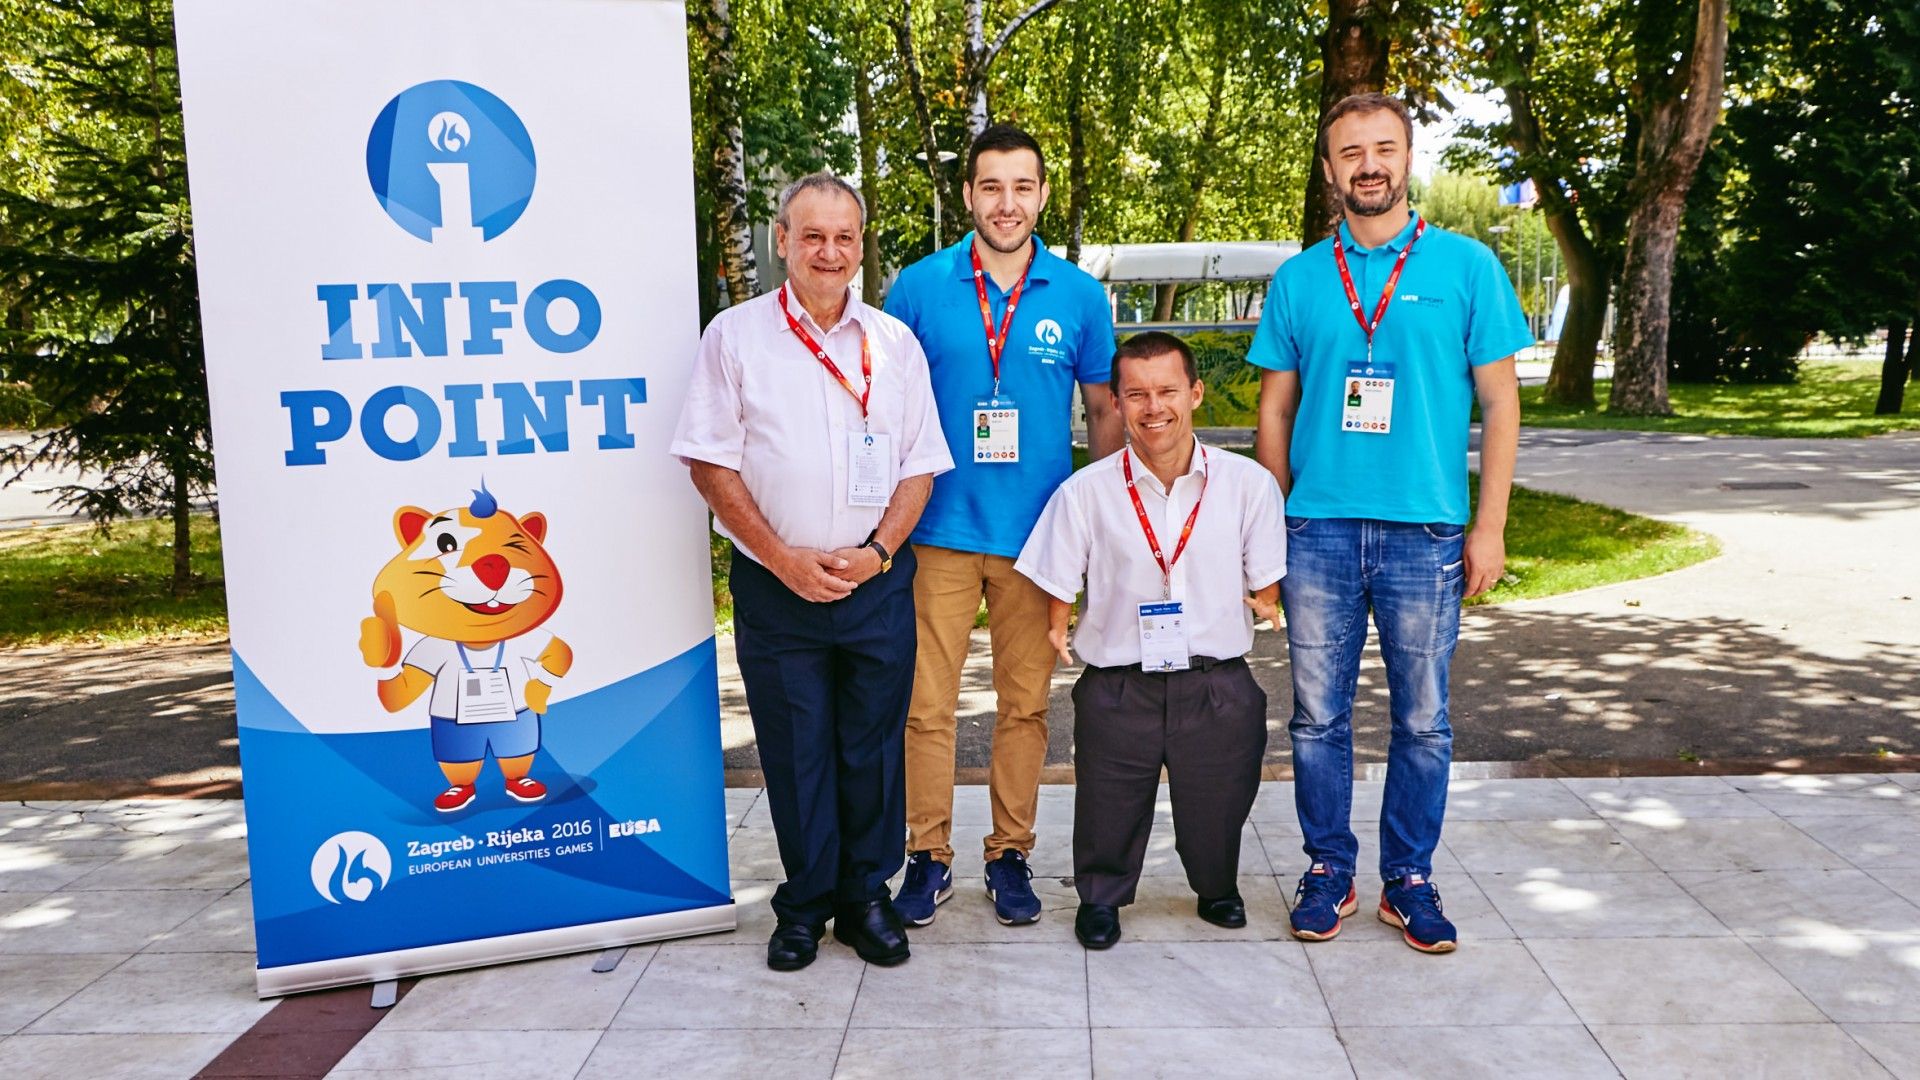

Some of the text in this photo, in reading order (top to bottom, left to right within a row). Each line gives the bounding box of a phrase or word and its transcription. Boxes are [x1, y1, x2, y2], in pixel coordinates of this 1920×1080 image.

[317, 279, 602, 360] INFO
[280, 377, 648, 466] POINT
[407, 819, 592, 858] Zagreb Rijeka 2016
[608, 818, 662, 838] EUSA
[408, 842, 594, 876] EUROPEAN UNIVERSITIES GAMES
